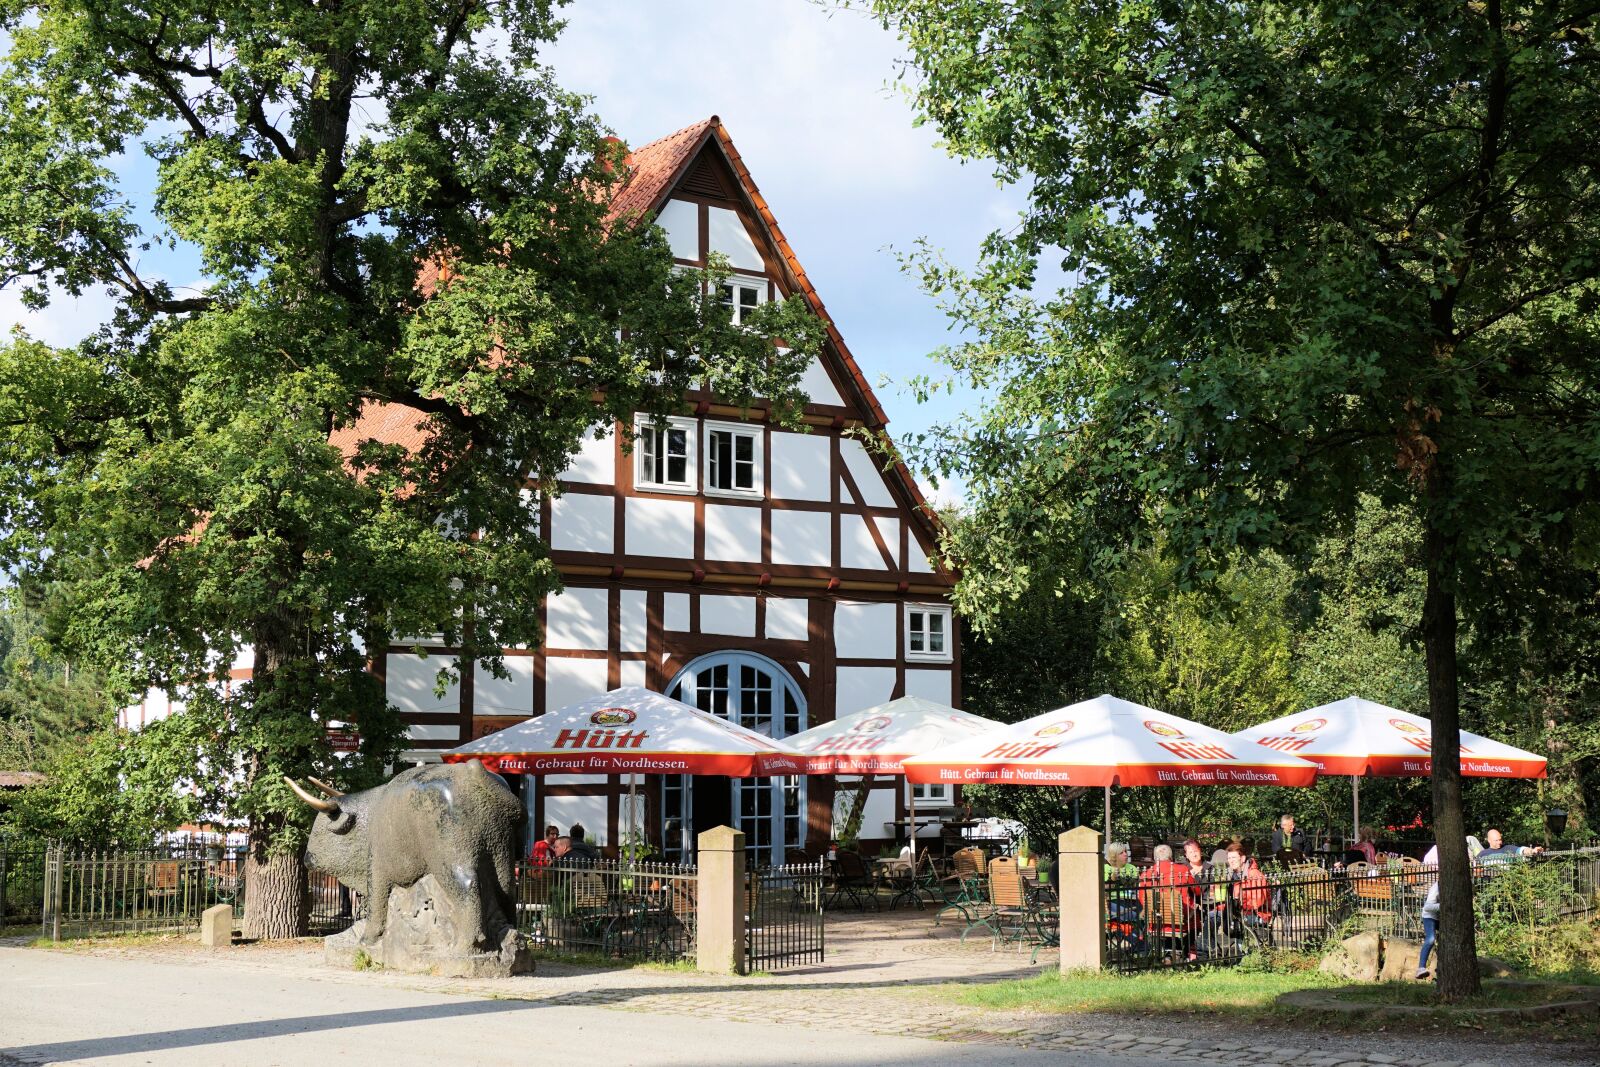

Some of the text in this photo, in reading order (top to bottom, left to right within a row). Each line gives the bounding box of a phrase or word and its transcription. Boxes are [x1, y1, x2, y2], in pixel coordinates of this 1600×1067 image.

[552, 729, 649, 749] Hütt
[981, 741, 1062, 758] Hütt
[1156, 741, 1238, 759] Hütt
[500, 757, 689, 769] Hütt. Gebraut für Nordhessen.
[834, 759, 847, 769] für
[1404, 762, 1422, 771] Hütt.
[1468, 763, 1513, 773] Nordhessen.
[940, 768, 1070, 780] Hütt. Gebraut für Nordhessen.
[1157, 769, 1280, 781] Hütt. Gebraut für Nordhessen.
